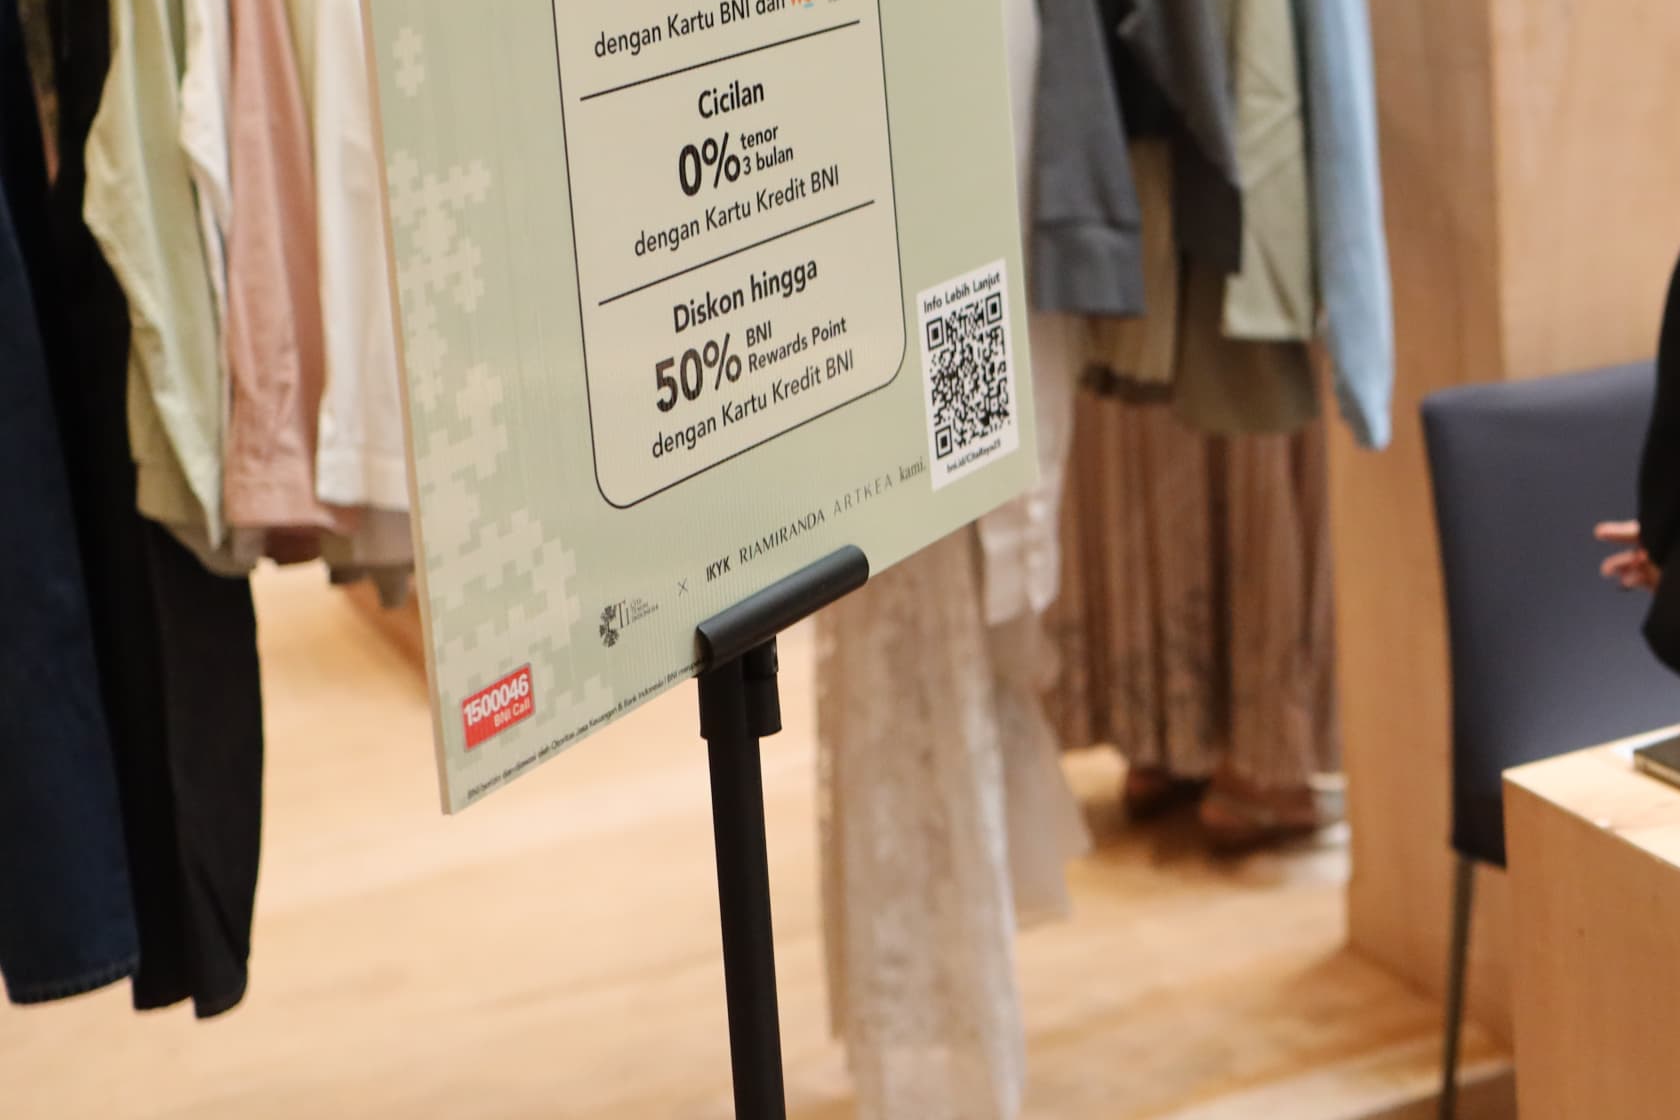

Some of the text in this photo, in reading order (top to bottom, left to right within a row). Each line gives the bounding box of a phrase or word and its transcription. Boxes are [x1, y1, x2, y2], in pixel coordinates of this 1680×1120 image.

[594, 23, 662, 58] dengan
[667, 11, 715, 39] Kartu
[698, 79, 765, 119] Cicilan
[678, 131, 741, 198] 0%
[740, 124, 779, 151] tenor
[742, 145, 794, 176] 3 bulan
[634, 164, 840, 257] dengan Kartu Kredit BNI
[673, 259, 818, 334] Diskon hingga
[923, 271, 1001, 314] Info Lebih Lanjut
[746, 320, 773, 348] BNI
[749, 316, 848, 374] Rewards Point
[655, 332, 743, 413] 50%
[652, 348, 855, 459] dengan Kartu Kredit BNI
[705, 555, 732, 583] IKYK
[739, 508, 826, 565] RIAMIRANDA
[833, 480, 893, 517] ARTKEA
[899, 455, 927, 483] kami.
[464, 673, 529, 727] 1500046
[494, 697, 530, 728] BNI Call
